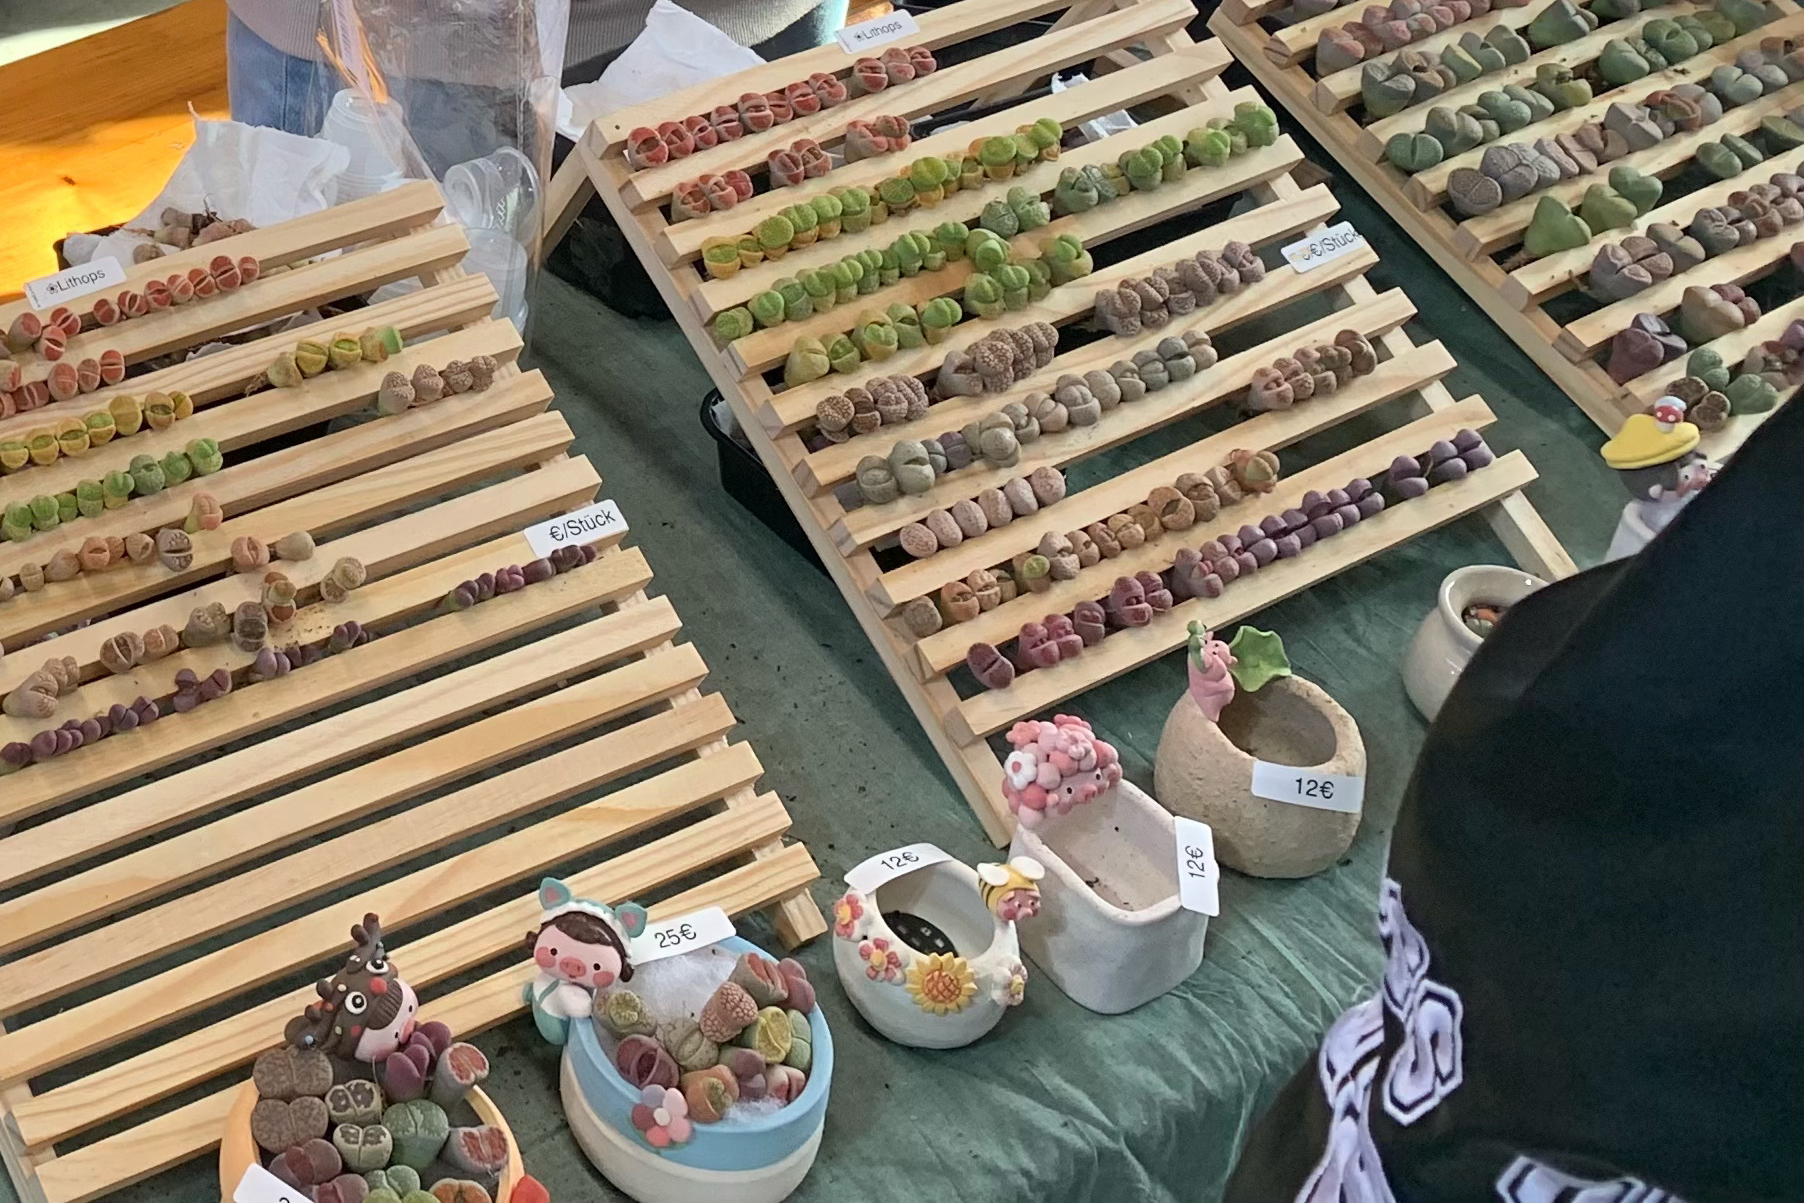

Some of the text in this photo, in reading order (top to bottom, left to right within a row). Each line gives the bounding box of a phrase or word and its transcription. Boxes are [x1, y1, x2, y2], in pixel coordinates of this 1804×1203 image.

[862, 21, 902, 40] Lithops
[57, 269, 106, 291] Lithops
[549, 509, 616, 541] €/Stück
[1296, 778, 1334, 799] 12€
[881, 851, 919, 870] 12€
[1185, 845, 1205, 878] 12€
[654, 924, 697, 948] 25€
